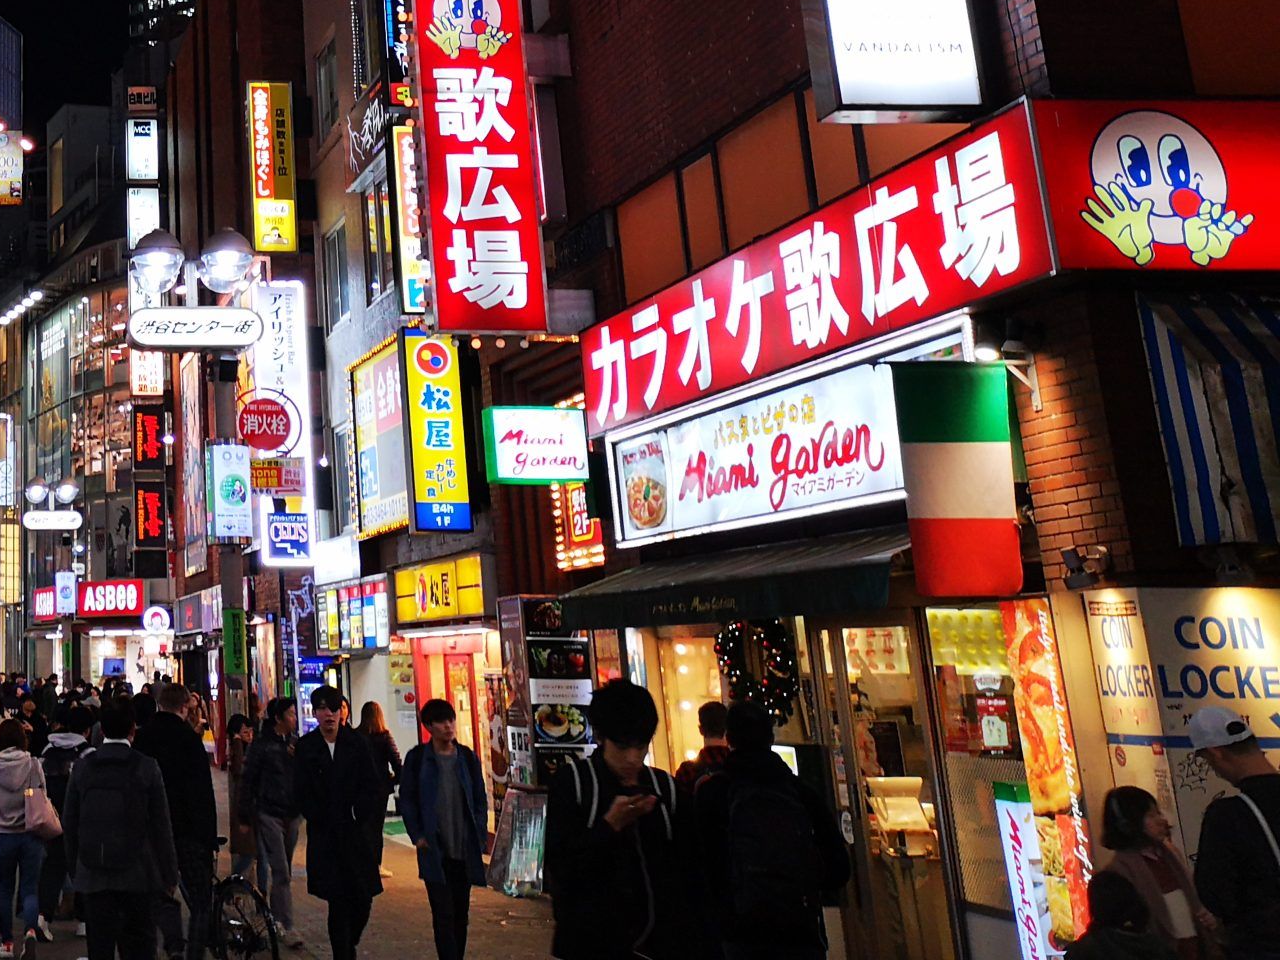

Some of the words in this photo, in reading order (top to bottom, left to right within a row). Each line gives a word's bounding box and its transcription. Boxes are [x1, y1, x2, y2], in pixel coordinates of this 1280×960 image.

[253, 88, 270, 197] 全身もみほぐし
[590, 130, 1021, 428] カラオケ歌広場
[136, 320, 255, 335] 渋谷センター街
[243, 414, 287, 436] 消火栓
[420, 383, 453, 450] 松屋
[499, 429, 564, 446] Miami
[425, 469, 436, 497] 定食
[435, 463, 446, 493] カレー
[444, 458, 457, 489] 牛めし
[679, 443, 759, 503] Miami
[791, 467, 866, 497] マイアミガーデン
[432, 503, 454, 514] 24h
[435, 515, 451, 527] 1F
[269, 522, 309, 543] CELTS
[573, 513, 590, 536] 2F
[84, 583, 138, 612] ASBee
[429, 572, 451, 609] 松屋
[1100, 615, 1134, 650] COIN
[1173, 615, 1266, 651] COIN
[1097, 664, 1155, 699] LOCKER
[1005, 808, 1032, 910] Miami
